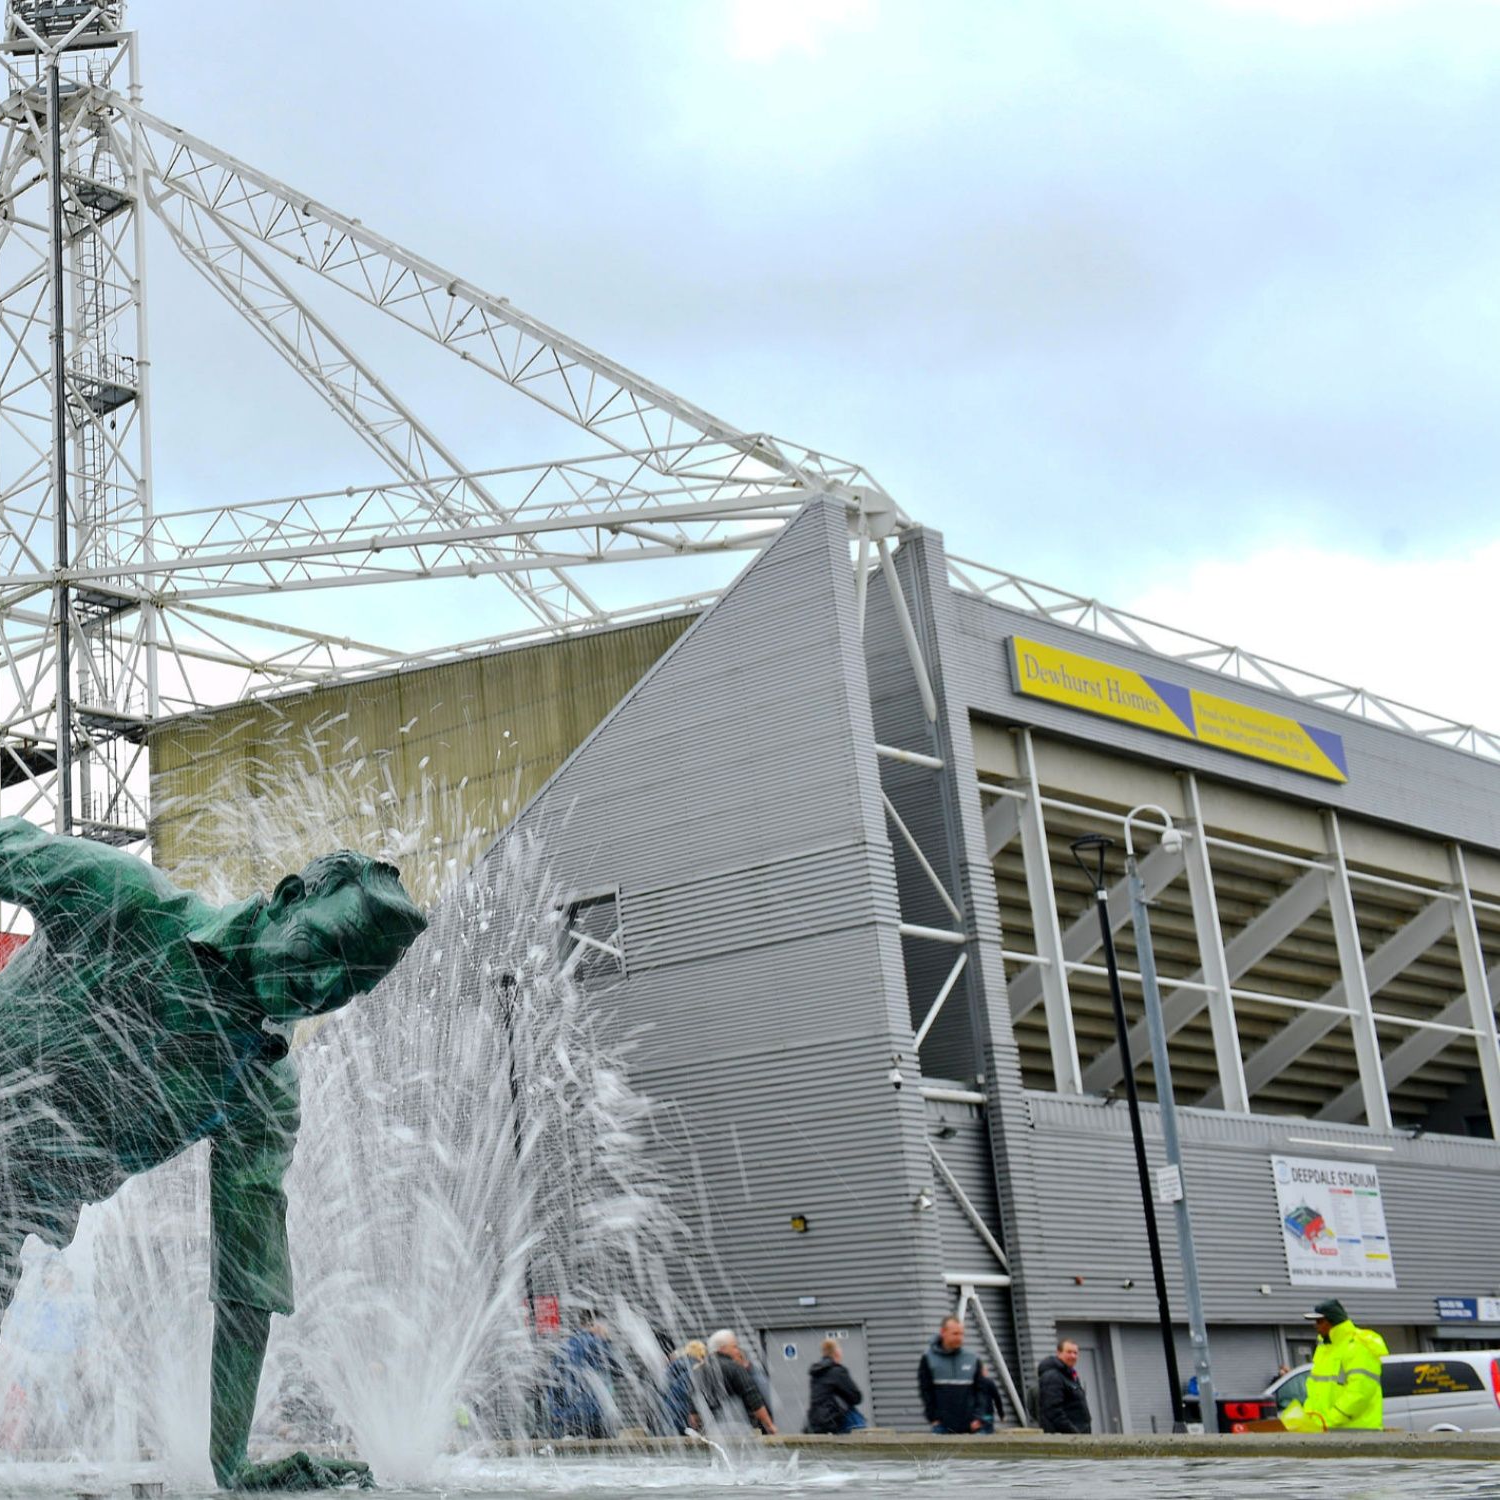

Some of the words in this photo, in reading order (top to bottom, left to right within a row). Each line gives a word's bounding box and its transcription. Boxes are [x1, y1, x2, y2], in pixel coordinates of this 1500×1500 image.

[1023, 653, 1103, 699] Dewhurst
[1106, 677, 1161, 715] Homes
[1291, 1167, 1336, 1185] DEEPDALE
[1339, 1170, 1376, 1188] STADIUM
